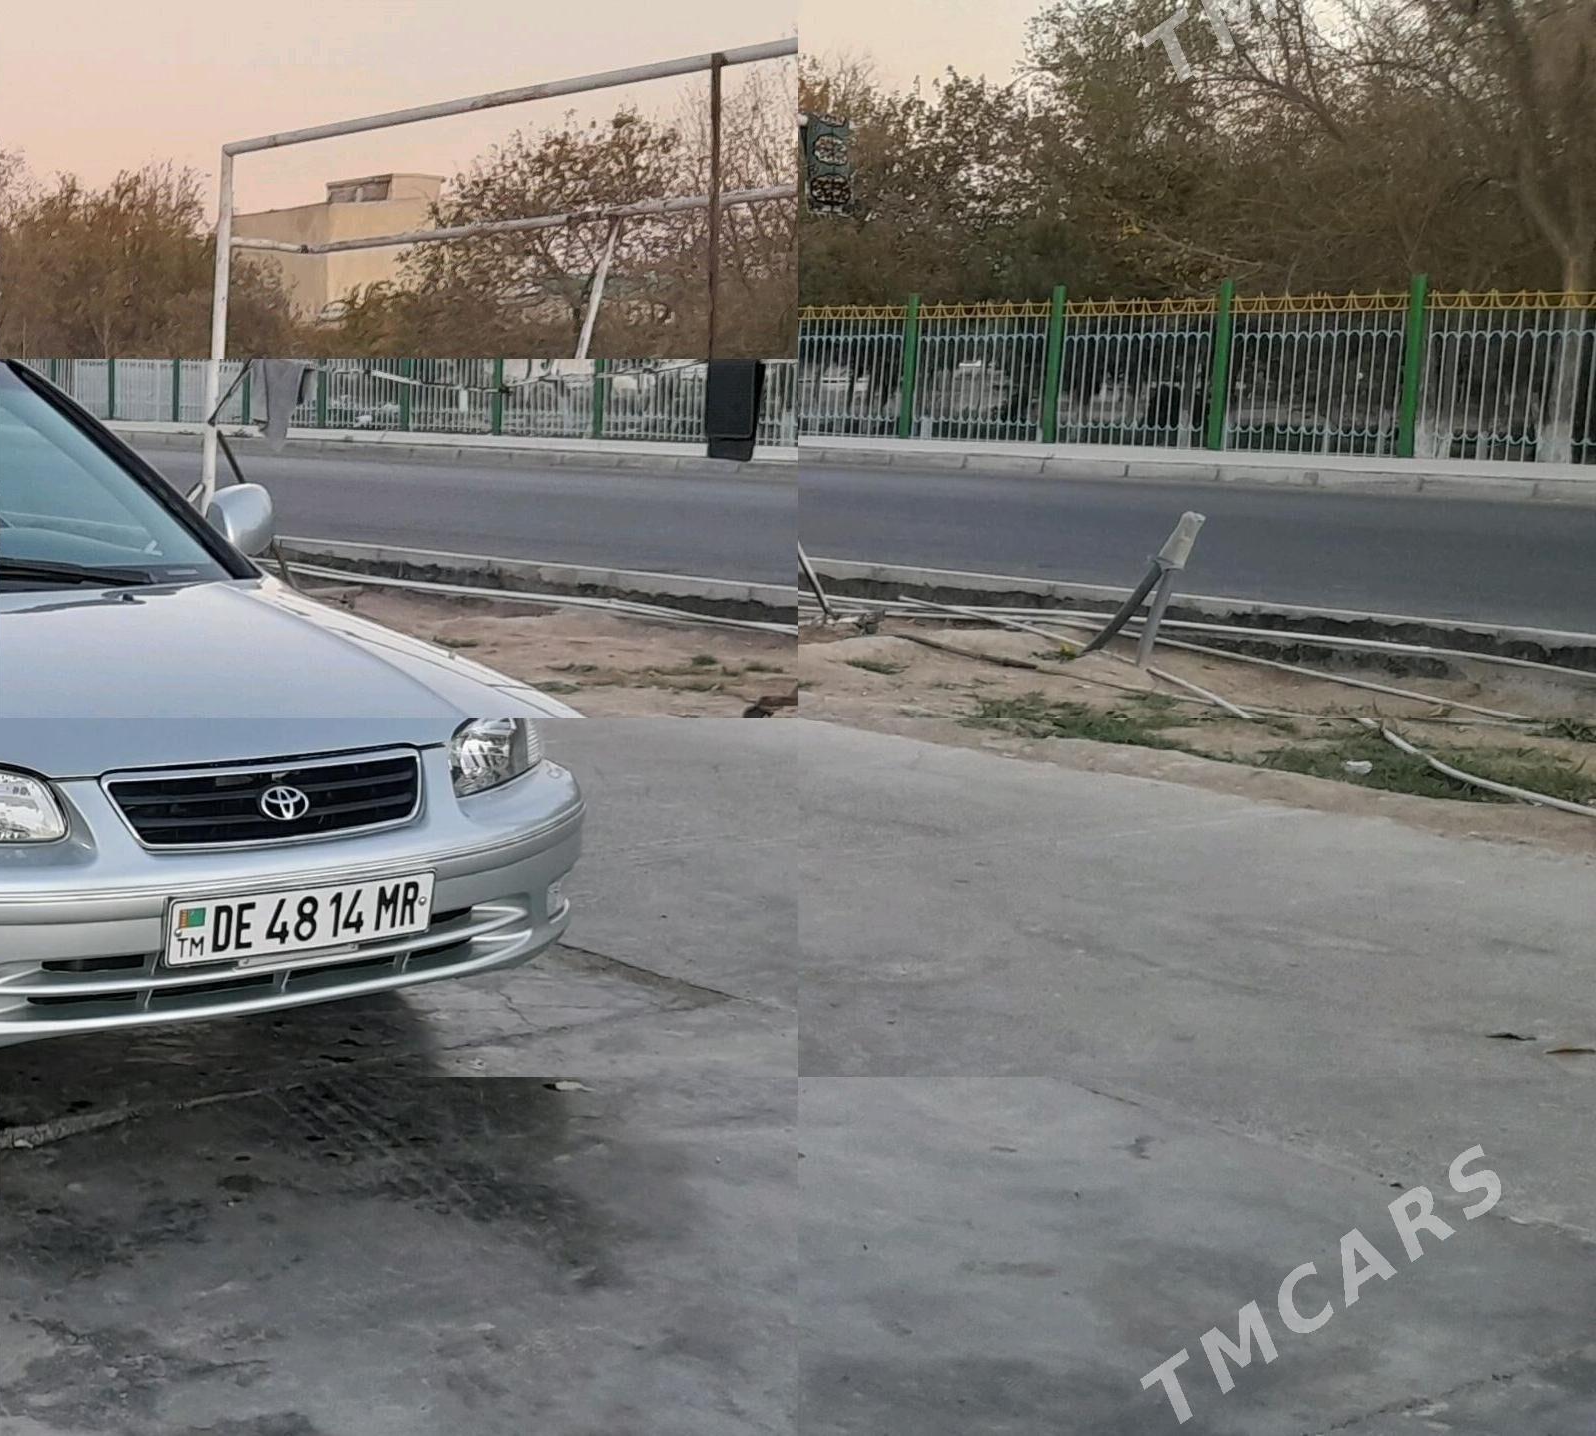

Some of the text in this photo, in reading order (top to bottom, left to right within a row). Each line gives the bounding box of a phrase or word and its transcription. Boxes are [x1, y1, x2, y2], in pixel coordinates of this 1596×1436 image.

[212, 902, 256, 953] DE
[374, 881, 419, 931] MR
[177, 936, 205, 958] TM
